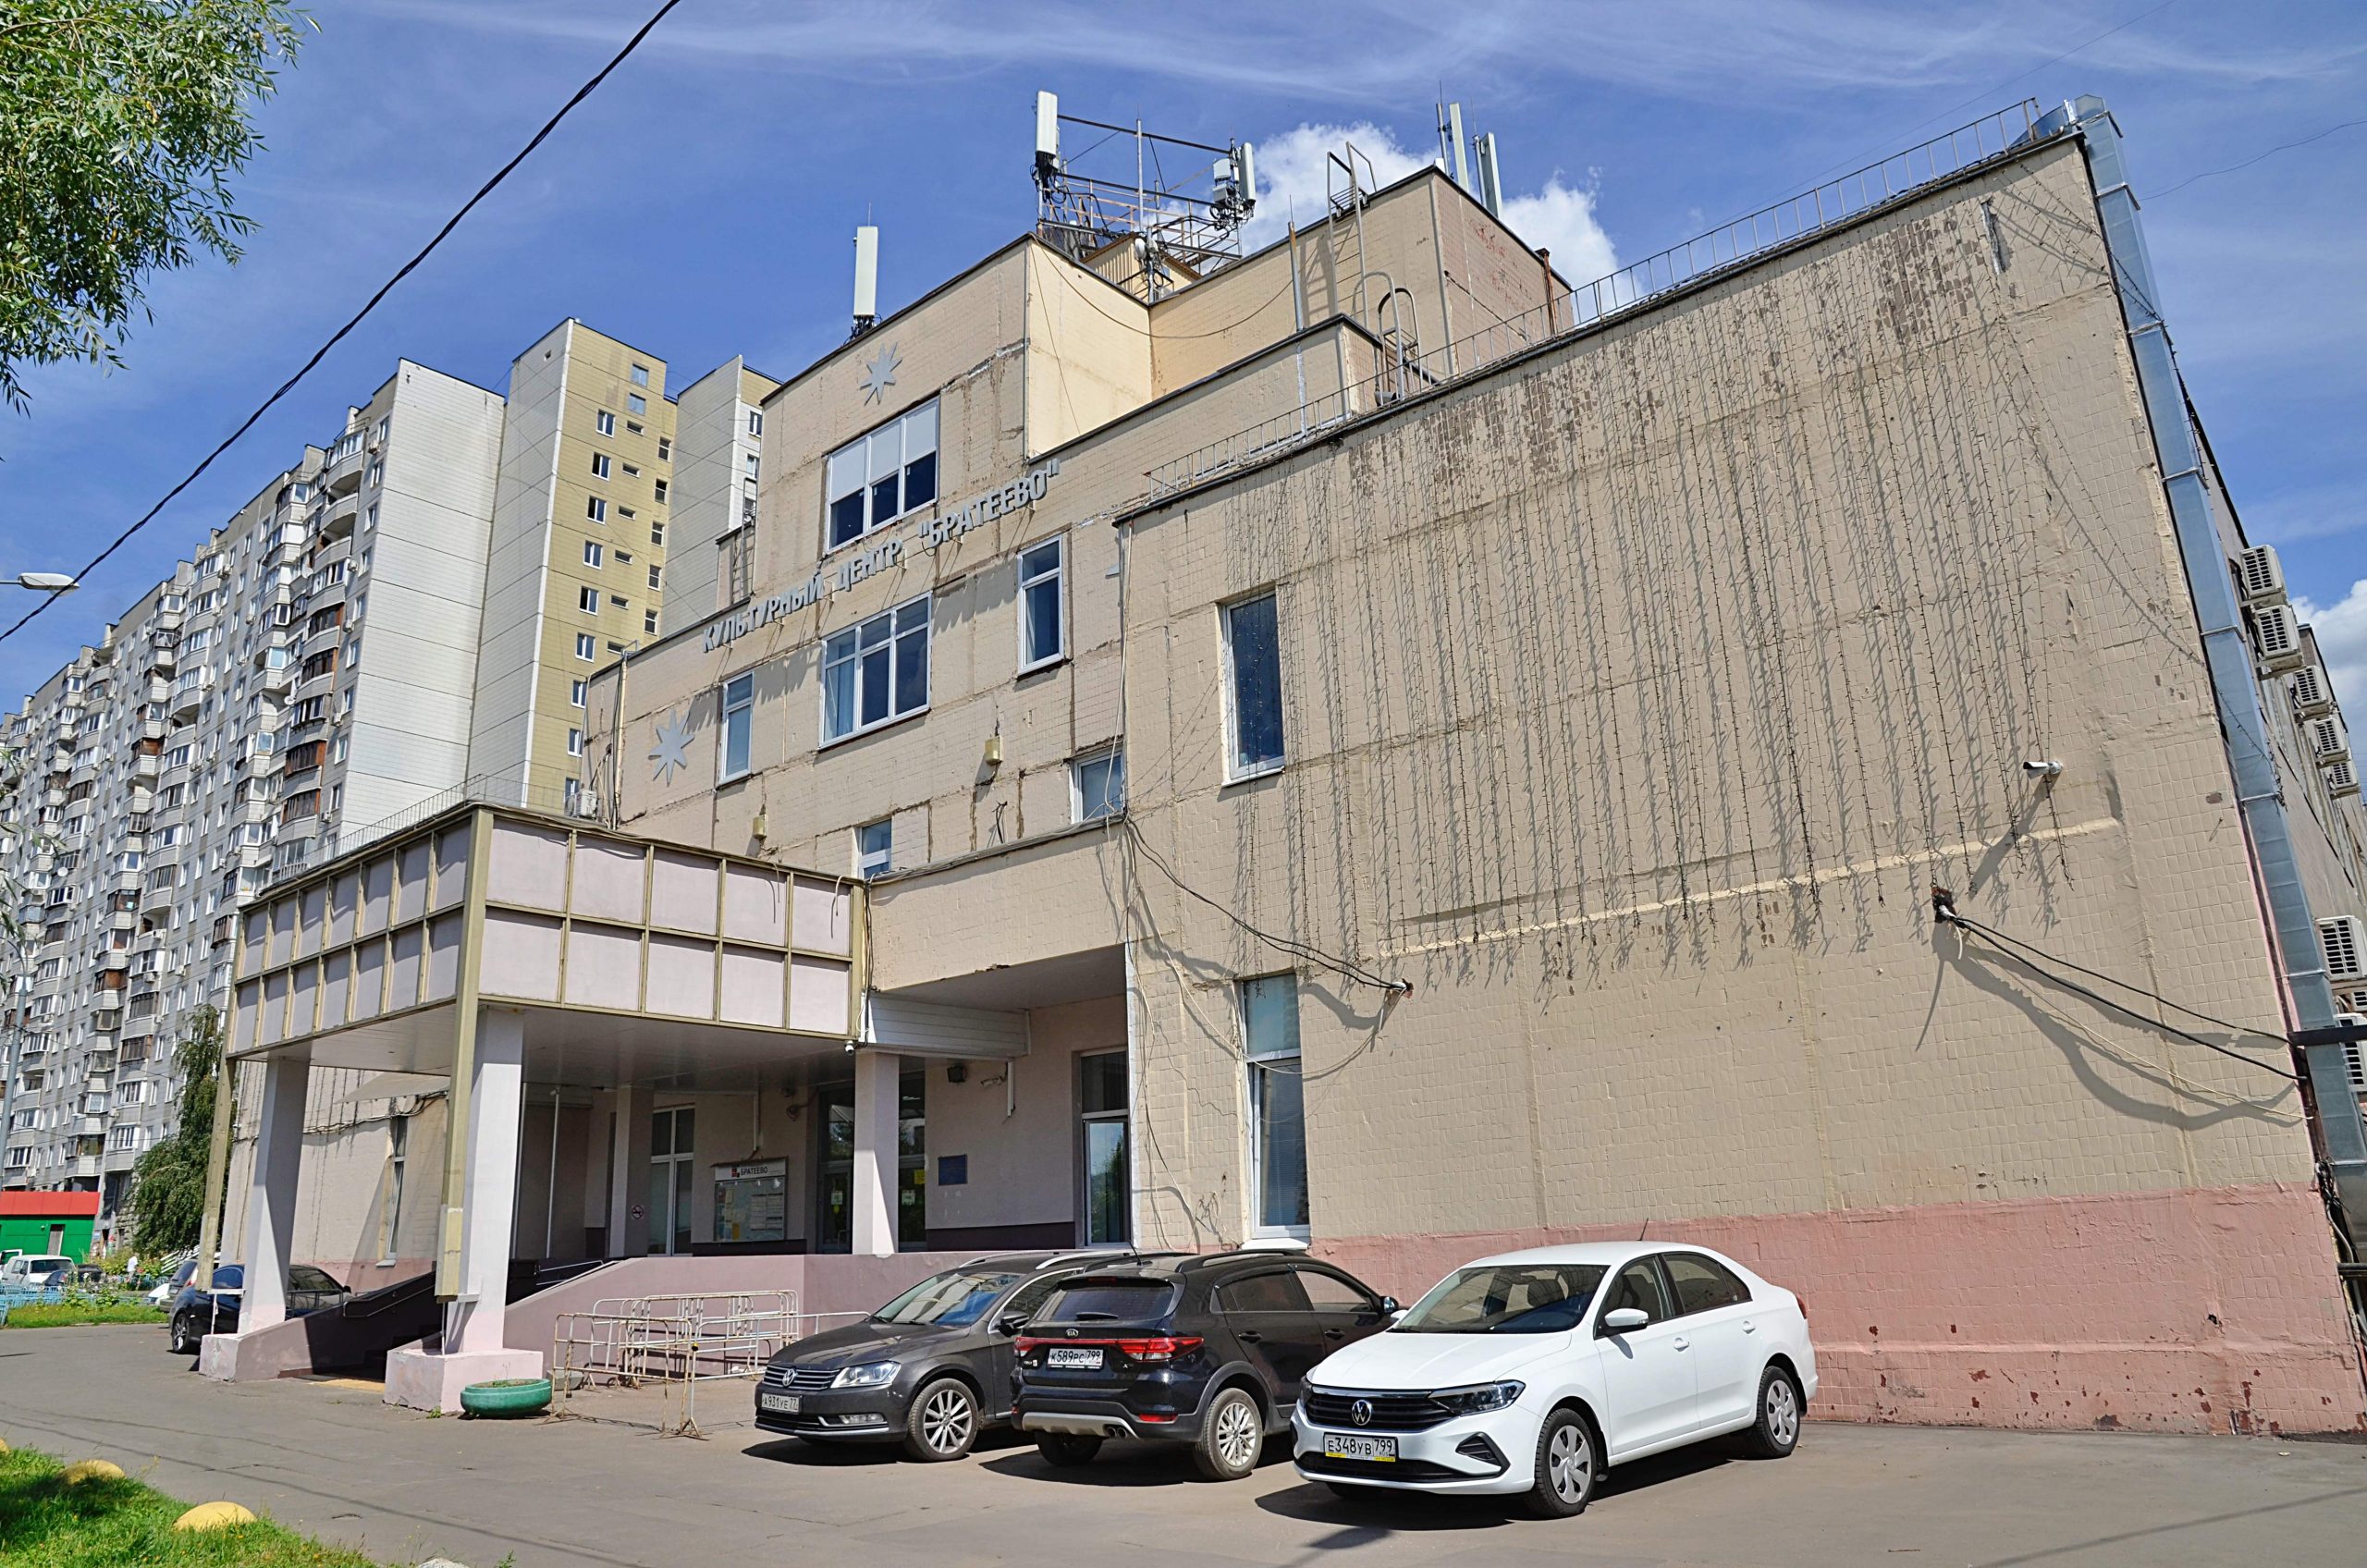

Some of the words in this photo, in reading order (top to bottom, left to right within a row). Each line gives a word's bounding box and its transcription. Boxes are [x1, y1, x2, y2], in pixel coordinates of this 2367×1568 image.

[703, 570, 825, 654] КУЛЬТУРНЫЙ
[836, 539, 903, 592] ЦЕНТР
[917, 459, 1061, 549] "БРАТЕЕВО"
[740, 1167, 768, 1176] БРАТЕЕВО
[1374, 1439, 1392, 1452] 799
